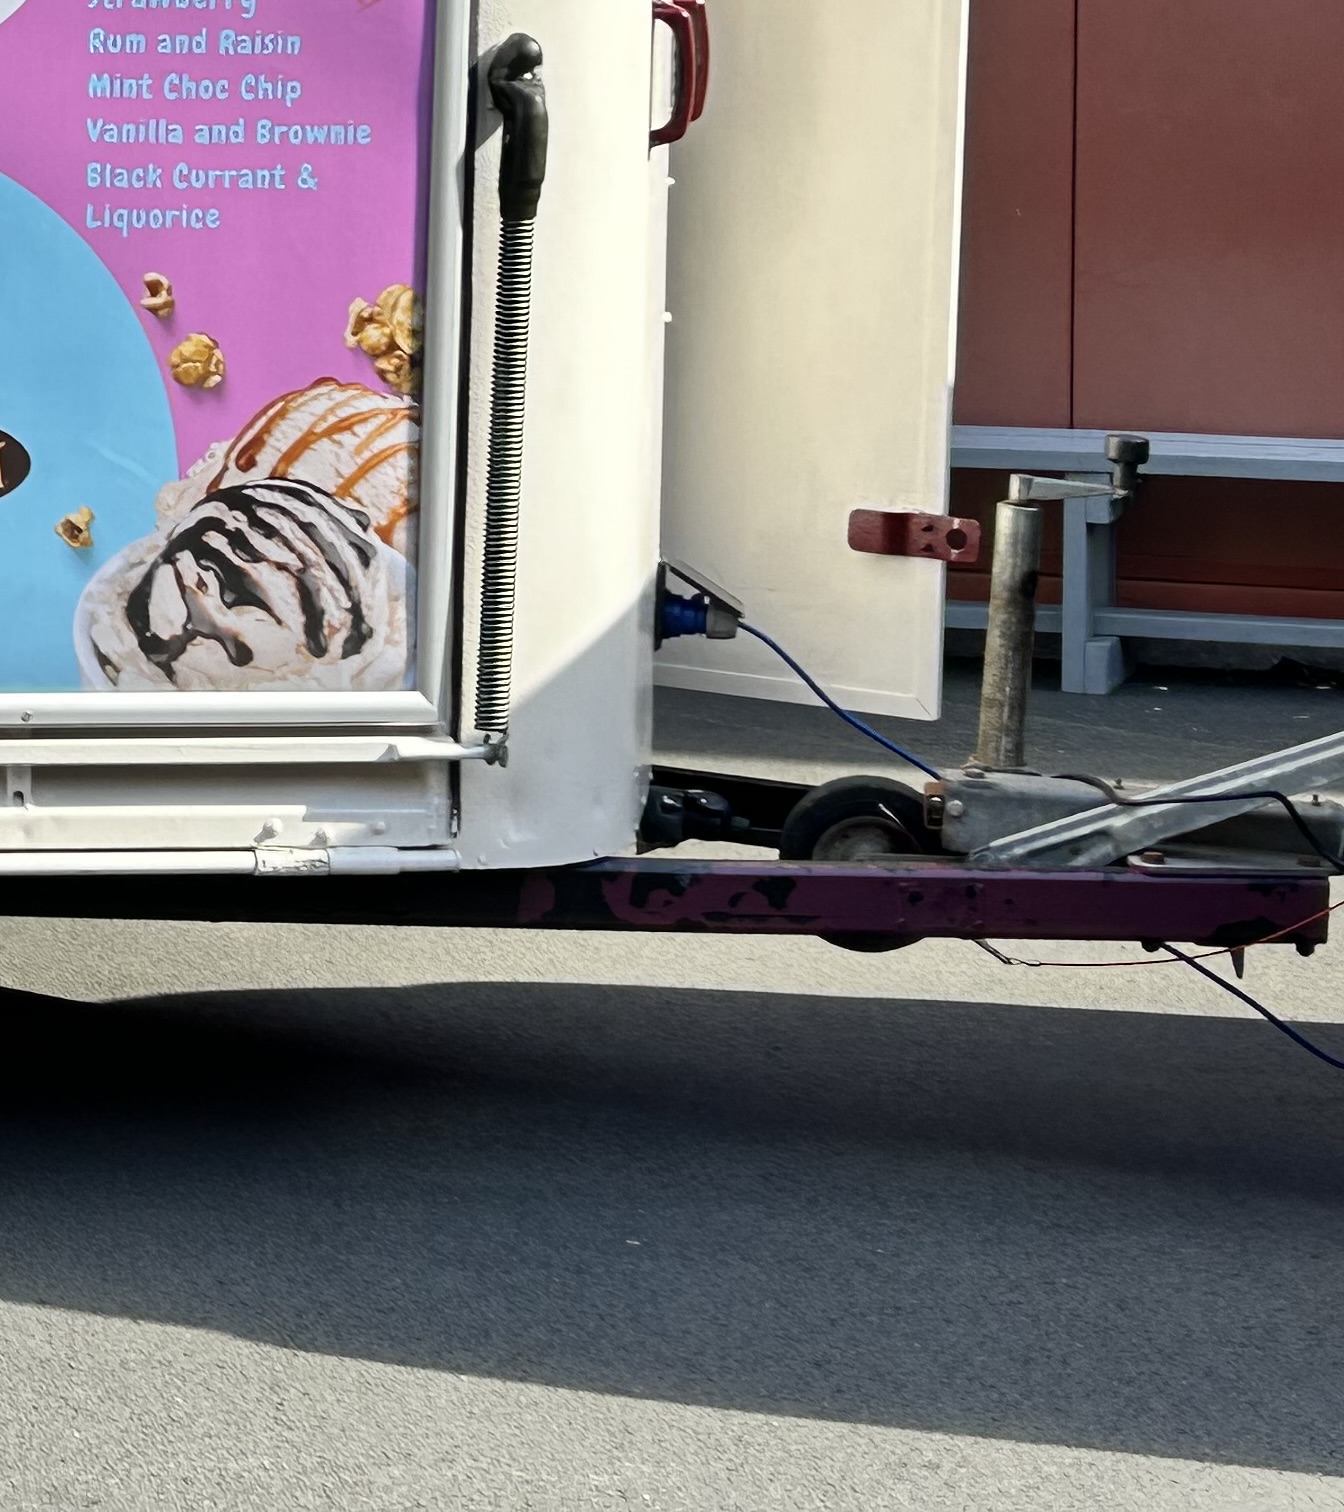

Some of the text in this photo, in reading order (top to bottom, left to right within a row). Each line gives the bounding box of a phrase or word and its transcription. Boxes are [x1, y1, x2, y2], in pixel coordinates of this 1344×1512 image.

[88, 28, 302, 56] Rum and Raisin
[87, 73, 302, 107] Mint Choc Chip
[86, 118, 373, 146] Vanilla and Brownie
[86, 162, 319, 191] Black Currant &
[85, 203, 221, 237] Liquorice
